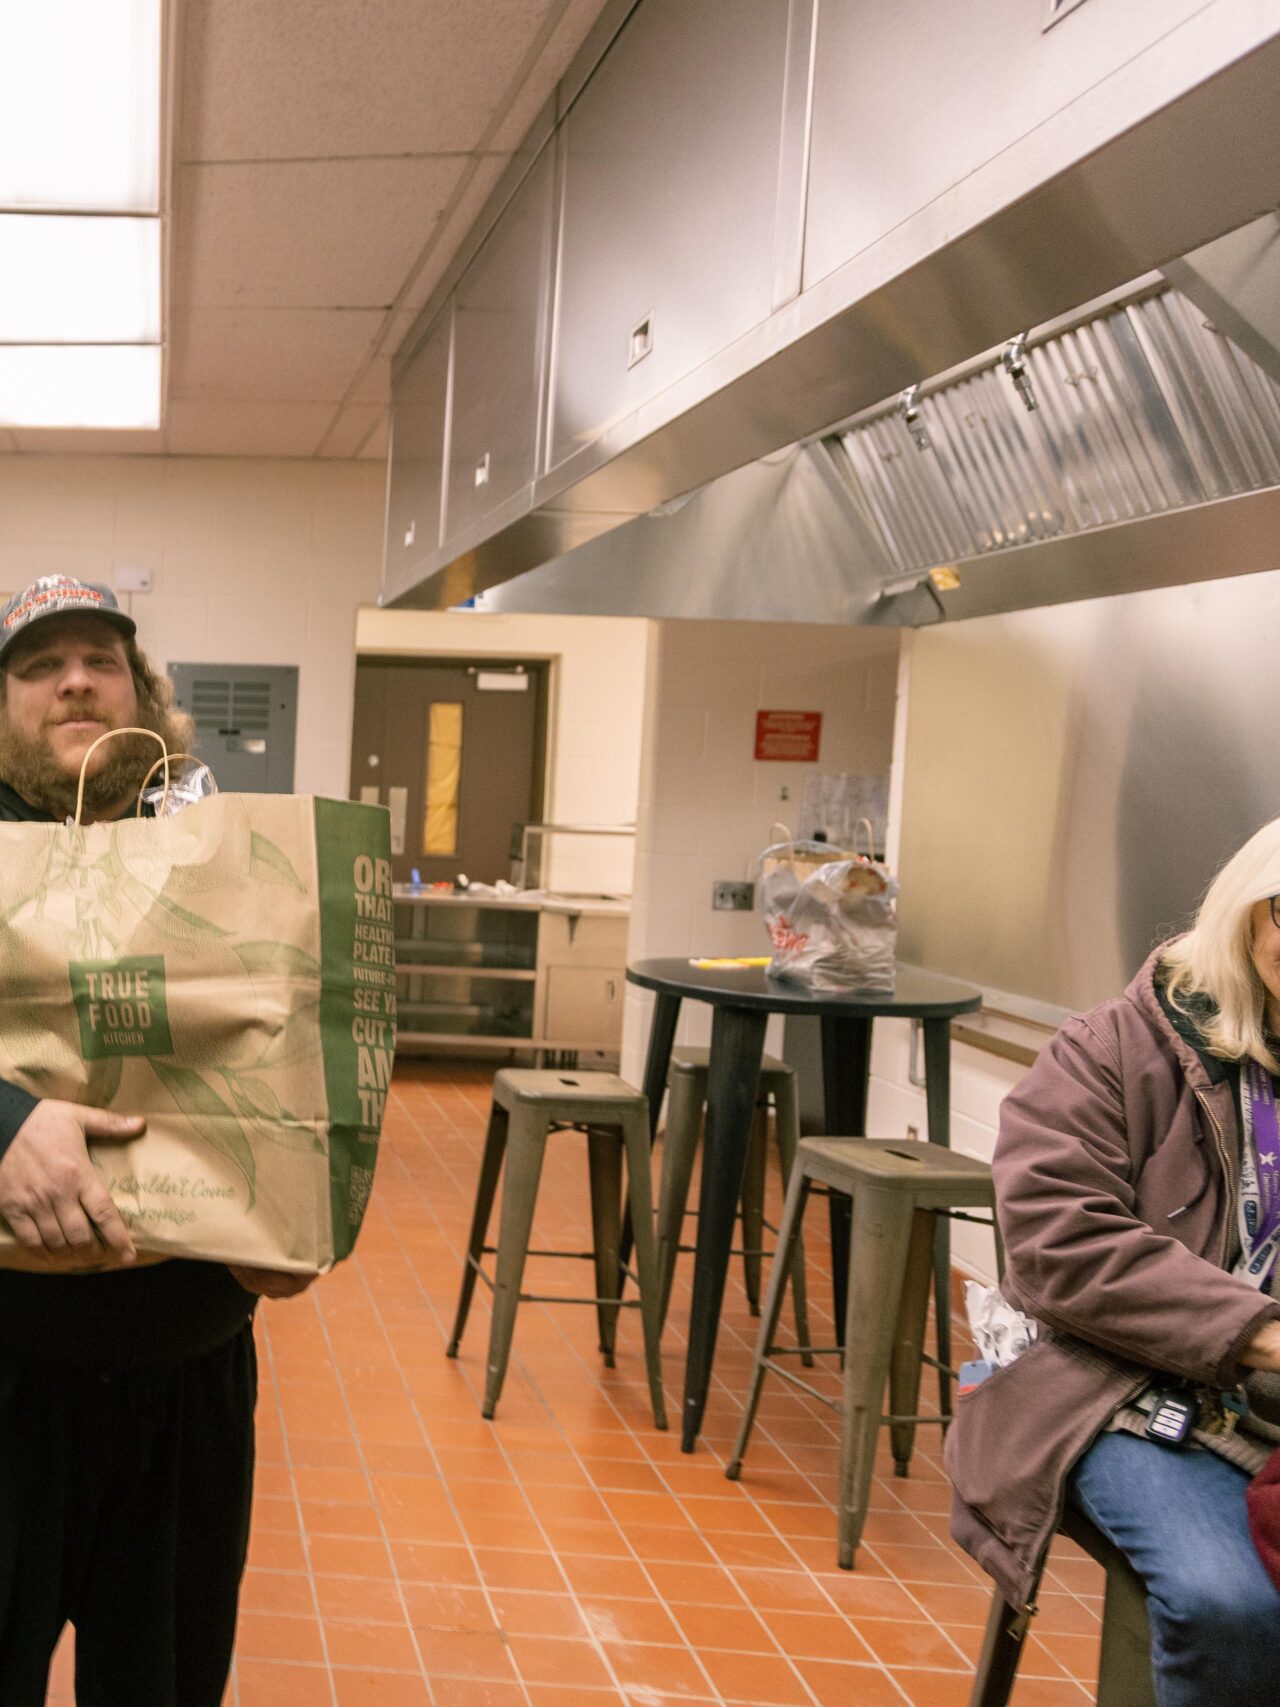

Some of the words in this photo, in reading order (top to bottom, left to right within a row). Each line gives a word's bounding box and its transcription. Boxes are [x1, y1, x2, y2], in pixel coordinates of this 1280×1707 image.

[354, 892, 391, 922] THAT
[85, 969, 150, 1001] TRUE
[354, 987, 380, 1012] SEE
[88, 1000, 152, 1032] FOOD
[352, 1015, 386, 1048] CUT
[102, 1031, 145, 1046] KITCHEN
